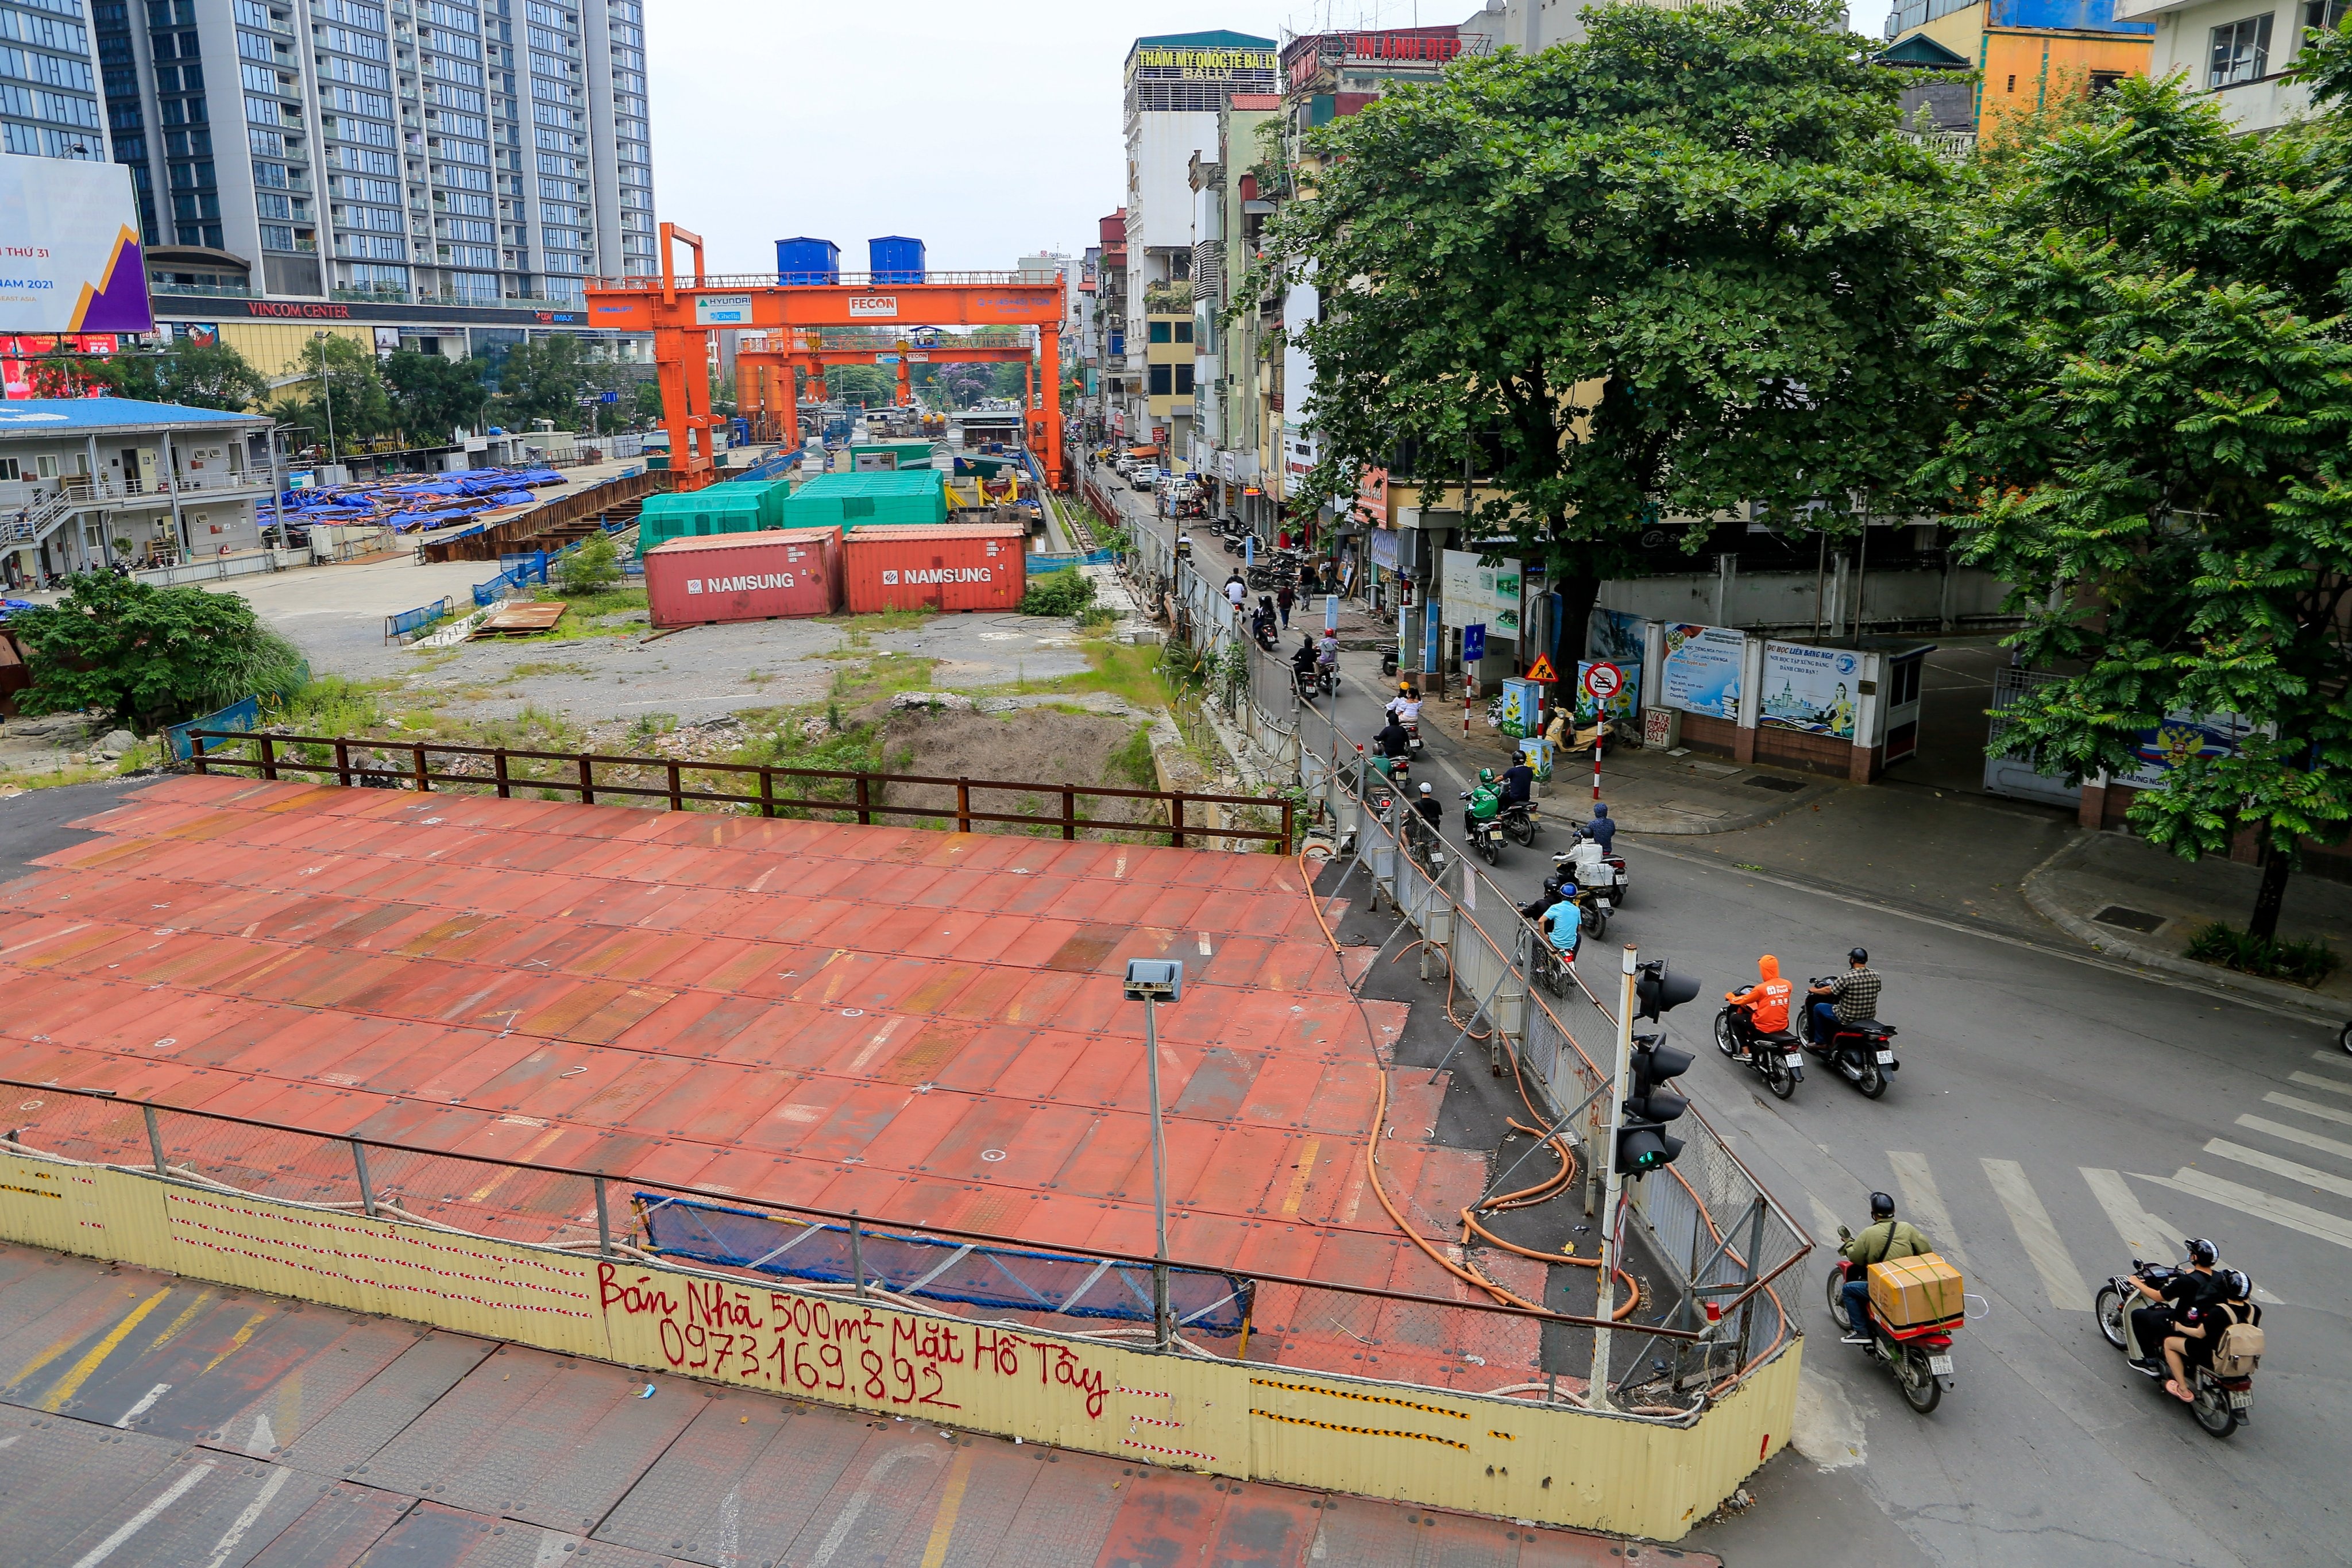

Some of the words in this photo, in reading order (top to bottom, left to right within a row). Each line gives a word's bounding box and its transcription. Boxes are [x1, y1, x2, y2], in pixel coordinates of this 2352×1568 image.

[1356, 37, 1374, 60] IN
[1183, 67, 1233, 80] BALLY
[6, 246, 34, 257] THỨ
[37, 248, 49, 257] 31
[27, 280, 53, 289] 2021
[248, 302, 302, 318] VINCOM
[303, 304, 350, 318] CENTER
[851, 298, 895, 309] FECON
[708, 572, 794, 593] NAMSUNG
[905, 567, 992, 585] NAMSUNG
[1776, 645, 1789, 654] HỌC
[1789, 647, 1803, 656] LIÊN
[1803, 650, 1821, 658] BANG
[597, 1261, 678, 1315] Bán
[891, 1317, 964, 1366] Mặt
[975, 1327, 1027, 1376] Hồ
[1030, 1341, 1110, 1419] Tây
[659, 1318, 961, 1409] 0973.169.892
